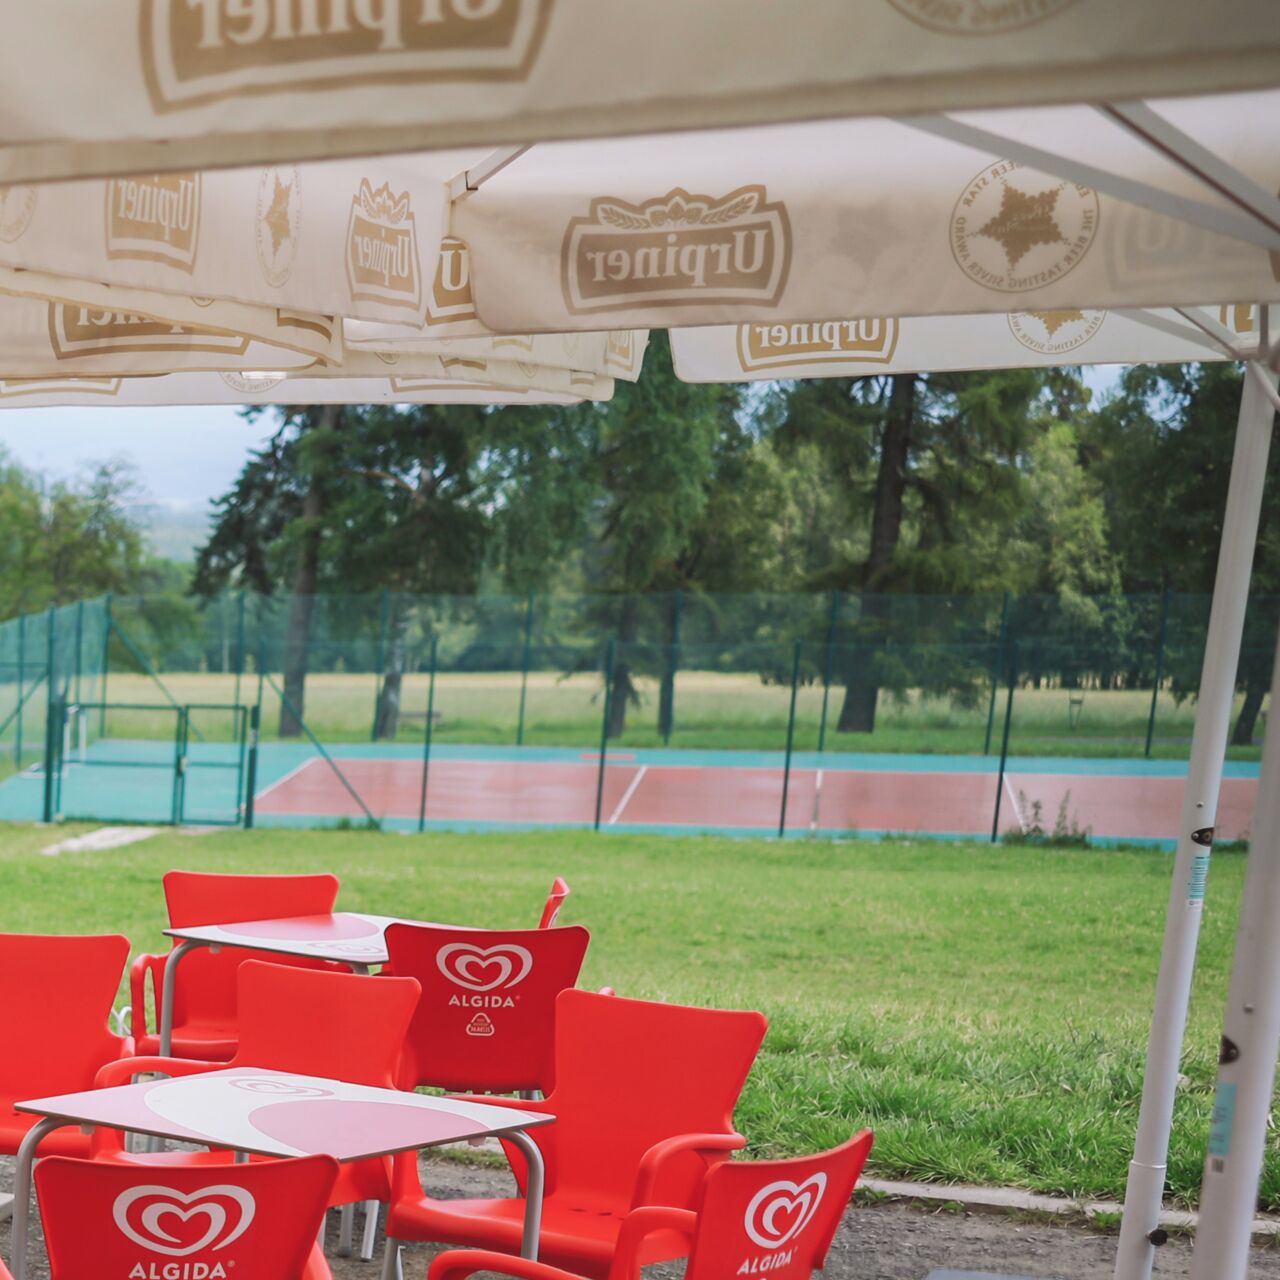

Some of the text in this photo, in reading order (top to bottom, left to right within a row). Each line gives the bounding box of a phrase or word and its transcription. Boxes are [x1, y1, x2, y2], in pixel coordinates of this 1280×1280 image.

[448, 994, 515, 1008] ALGIDA
[128, 1261, 227, 1280] ALGIDA
[736, 1250, 793, 1276] ALGIDA
